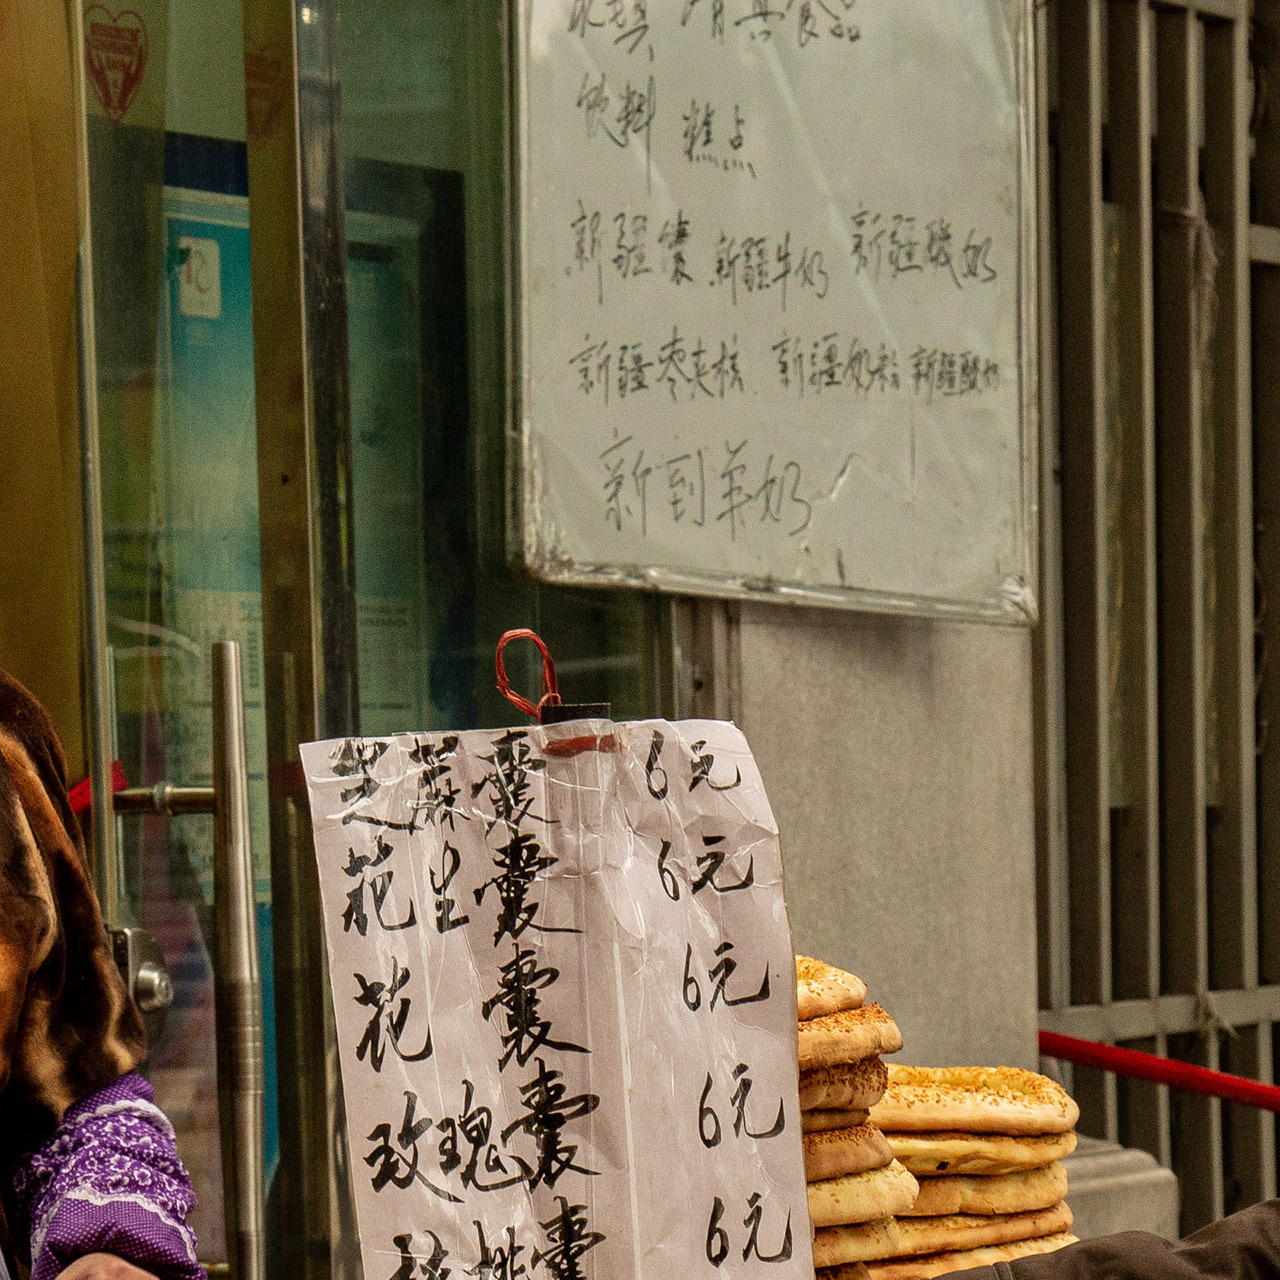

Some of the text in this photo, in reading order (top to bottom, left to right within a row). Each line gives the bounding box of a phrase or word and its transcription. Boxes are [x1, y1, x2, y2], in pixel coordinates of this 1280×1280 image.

[600, 428, 812, 542] 新到羊奶
[646, 729, 742, 800] 6元
[341, 834, 754, 947] 花生囊 6元
[682, 942, 771, 1012] 6元
[363, 1058, 785, 1203] 玫瑰囊 6元
[704, 1192, 794, 1268] 6元
